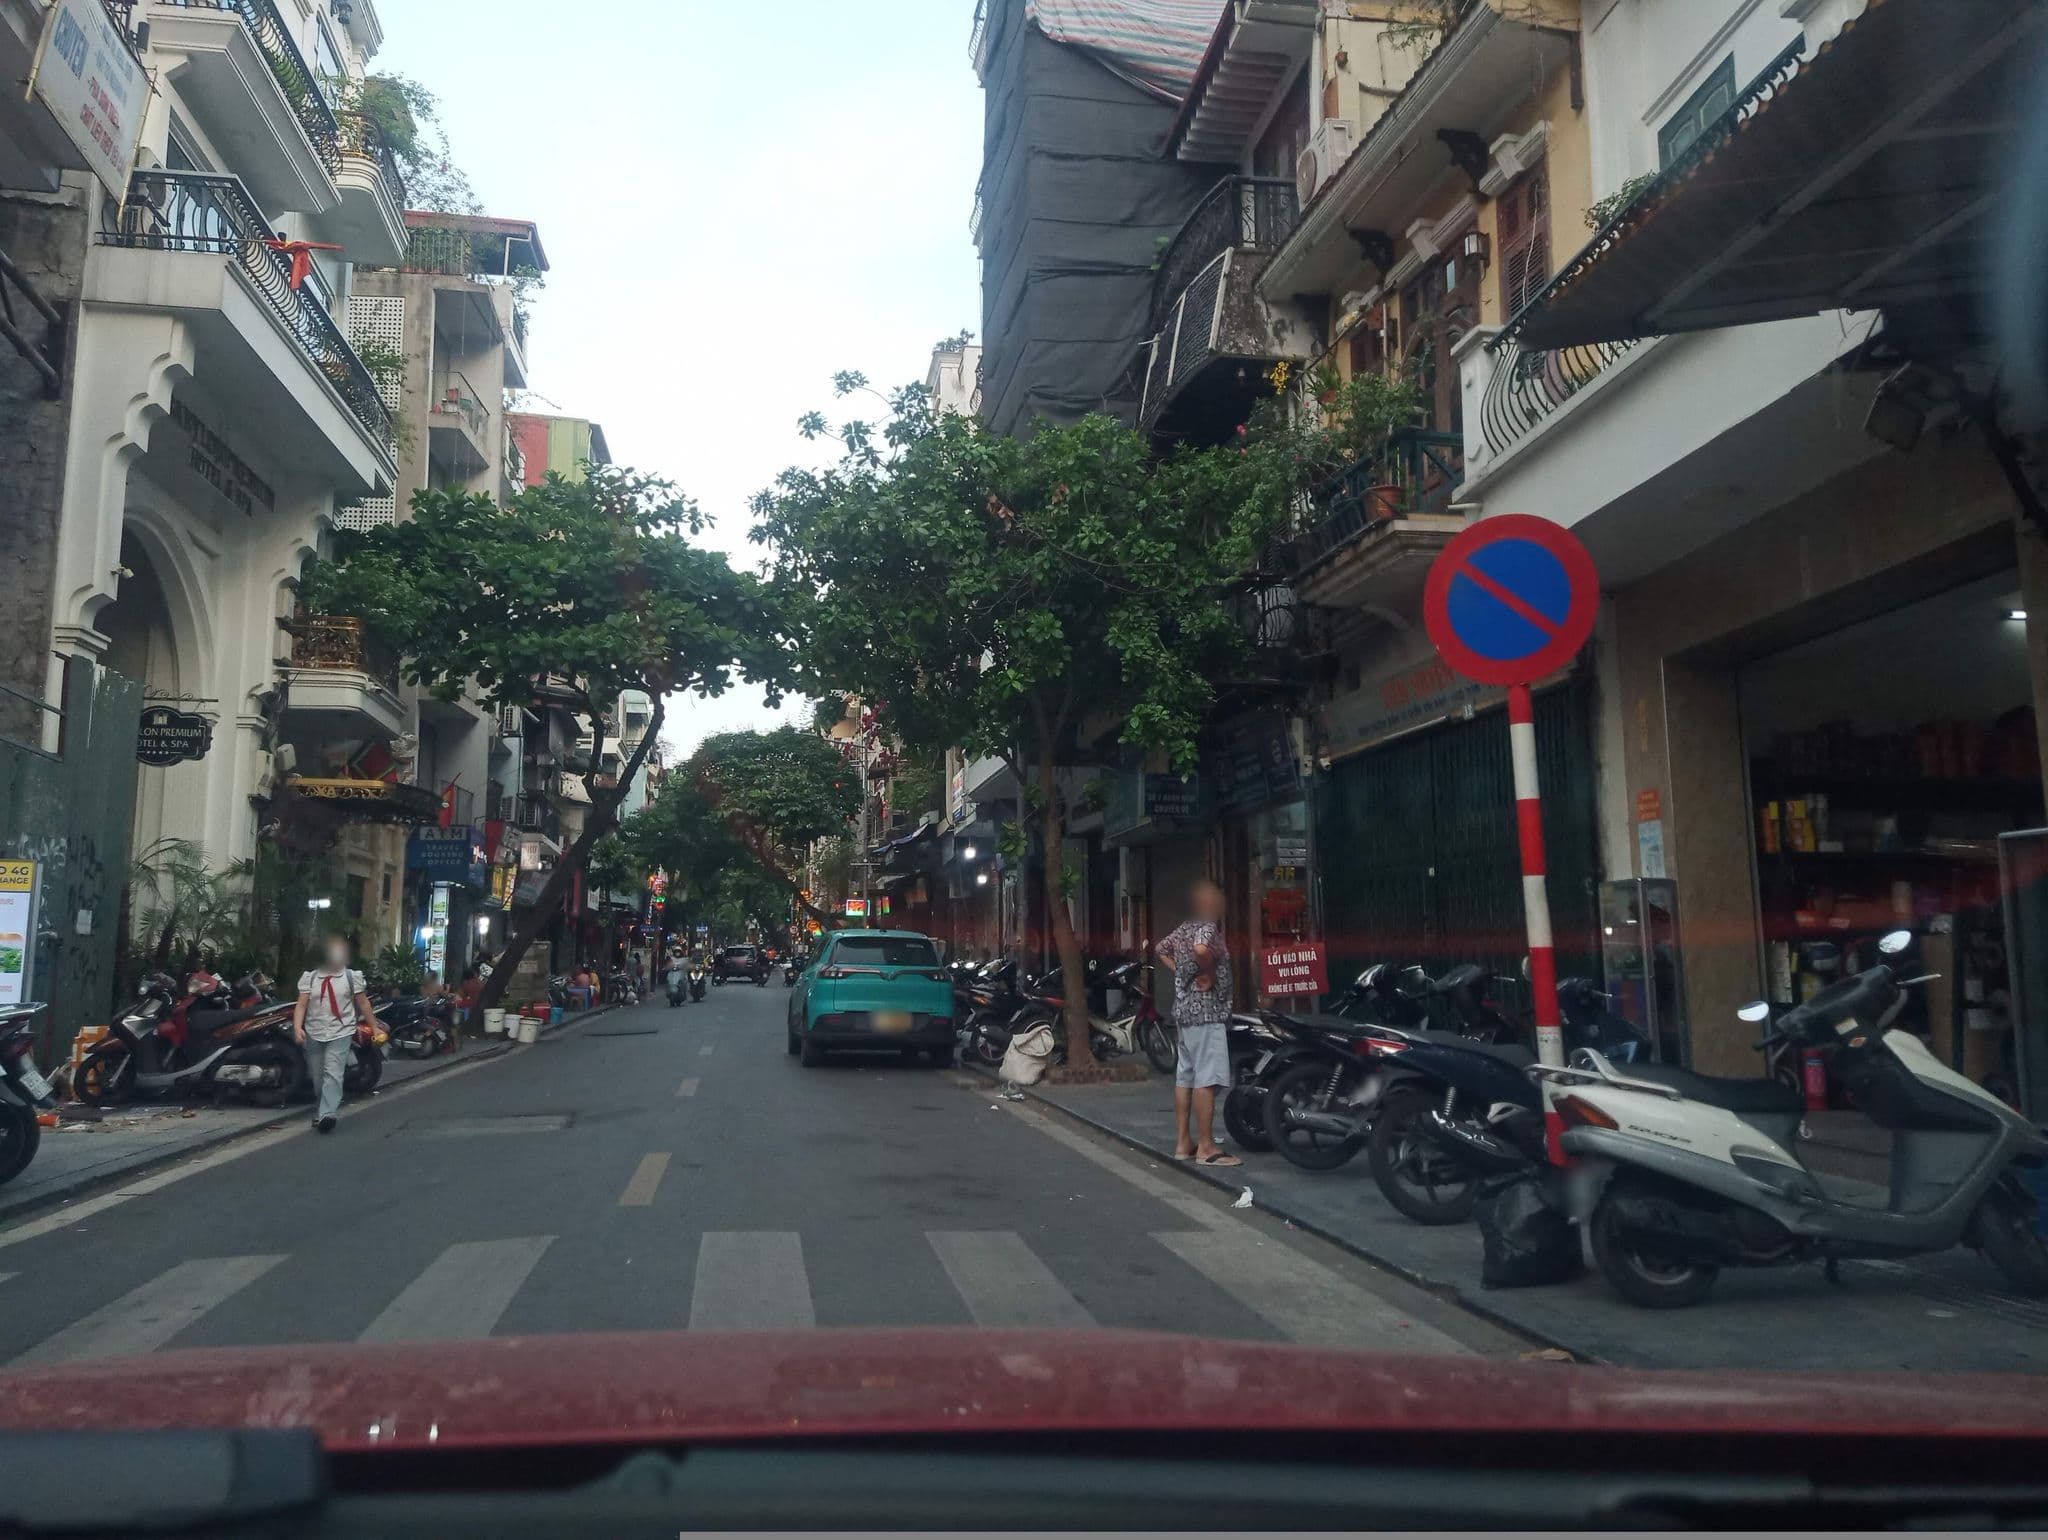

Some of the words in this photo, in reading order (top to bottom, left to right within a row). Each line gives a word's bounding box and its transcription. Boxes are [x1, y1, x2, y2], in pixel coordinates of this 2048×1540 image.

[160, 727, 201, 737] PREMIUM
[160, 740, 168, 748] &
[170, 740, 189, 748] SPA
[11, 866, 30, 876] 4G
